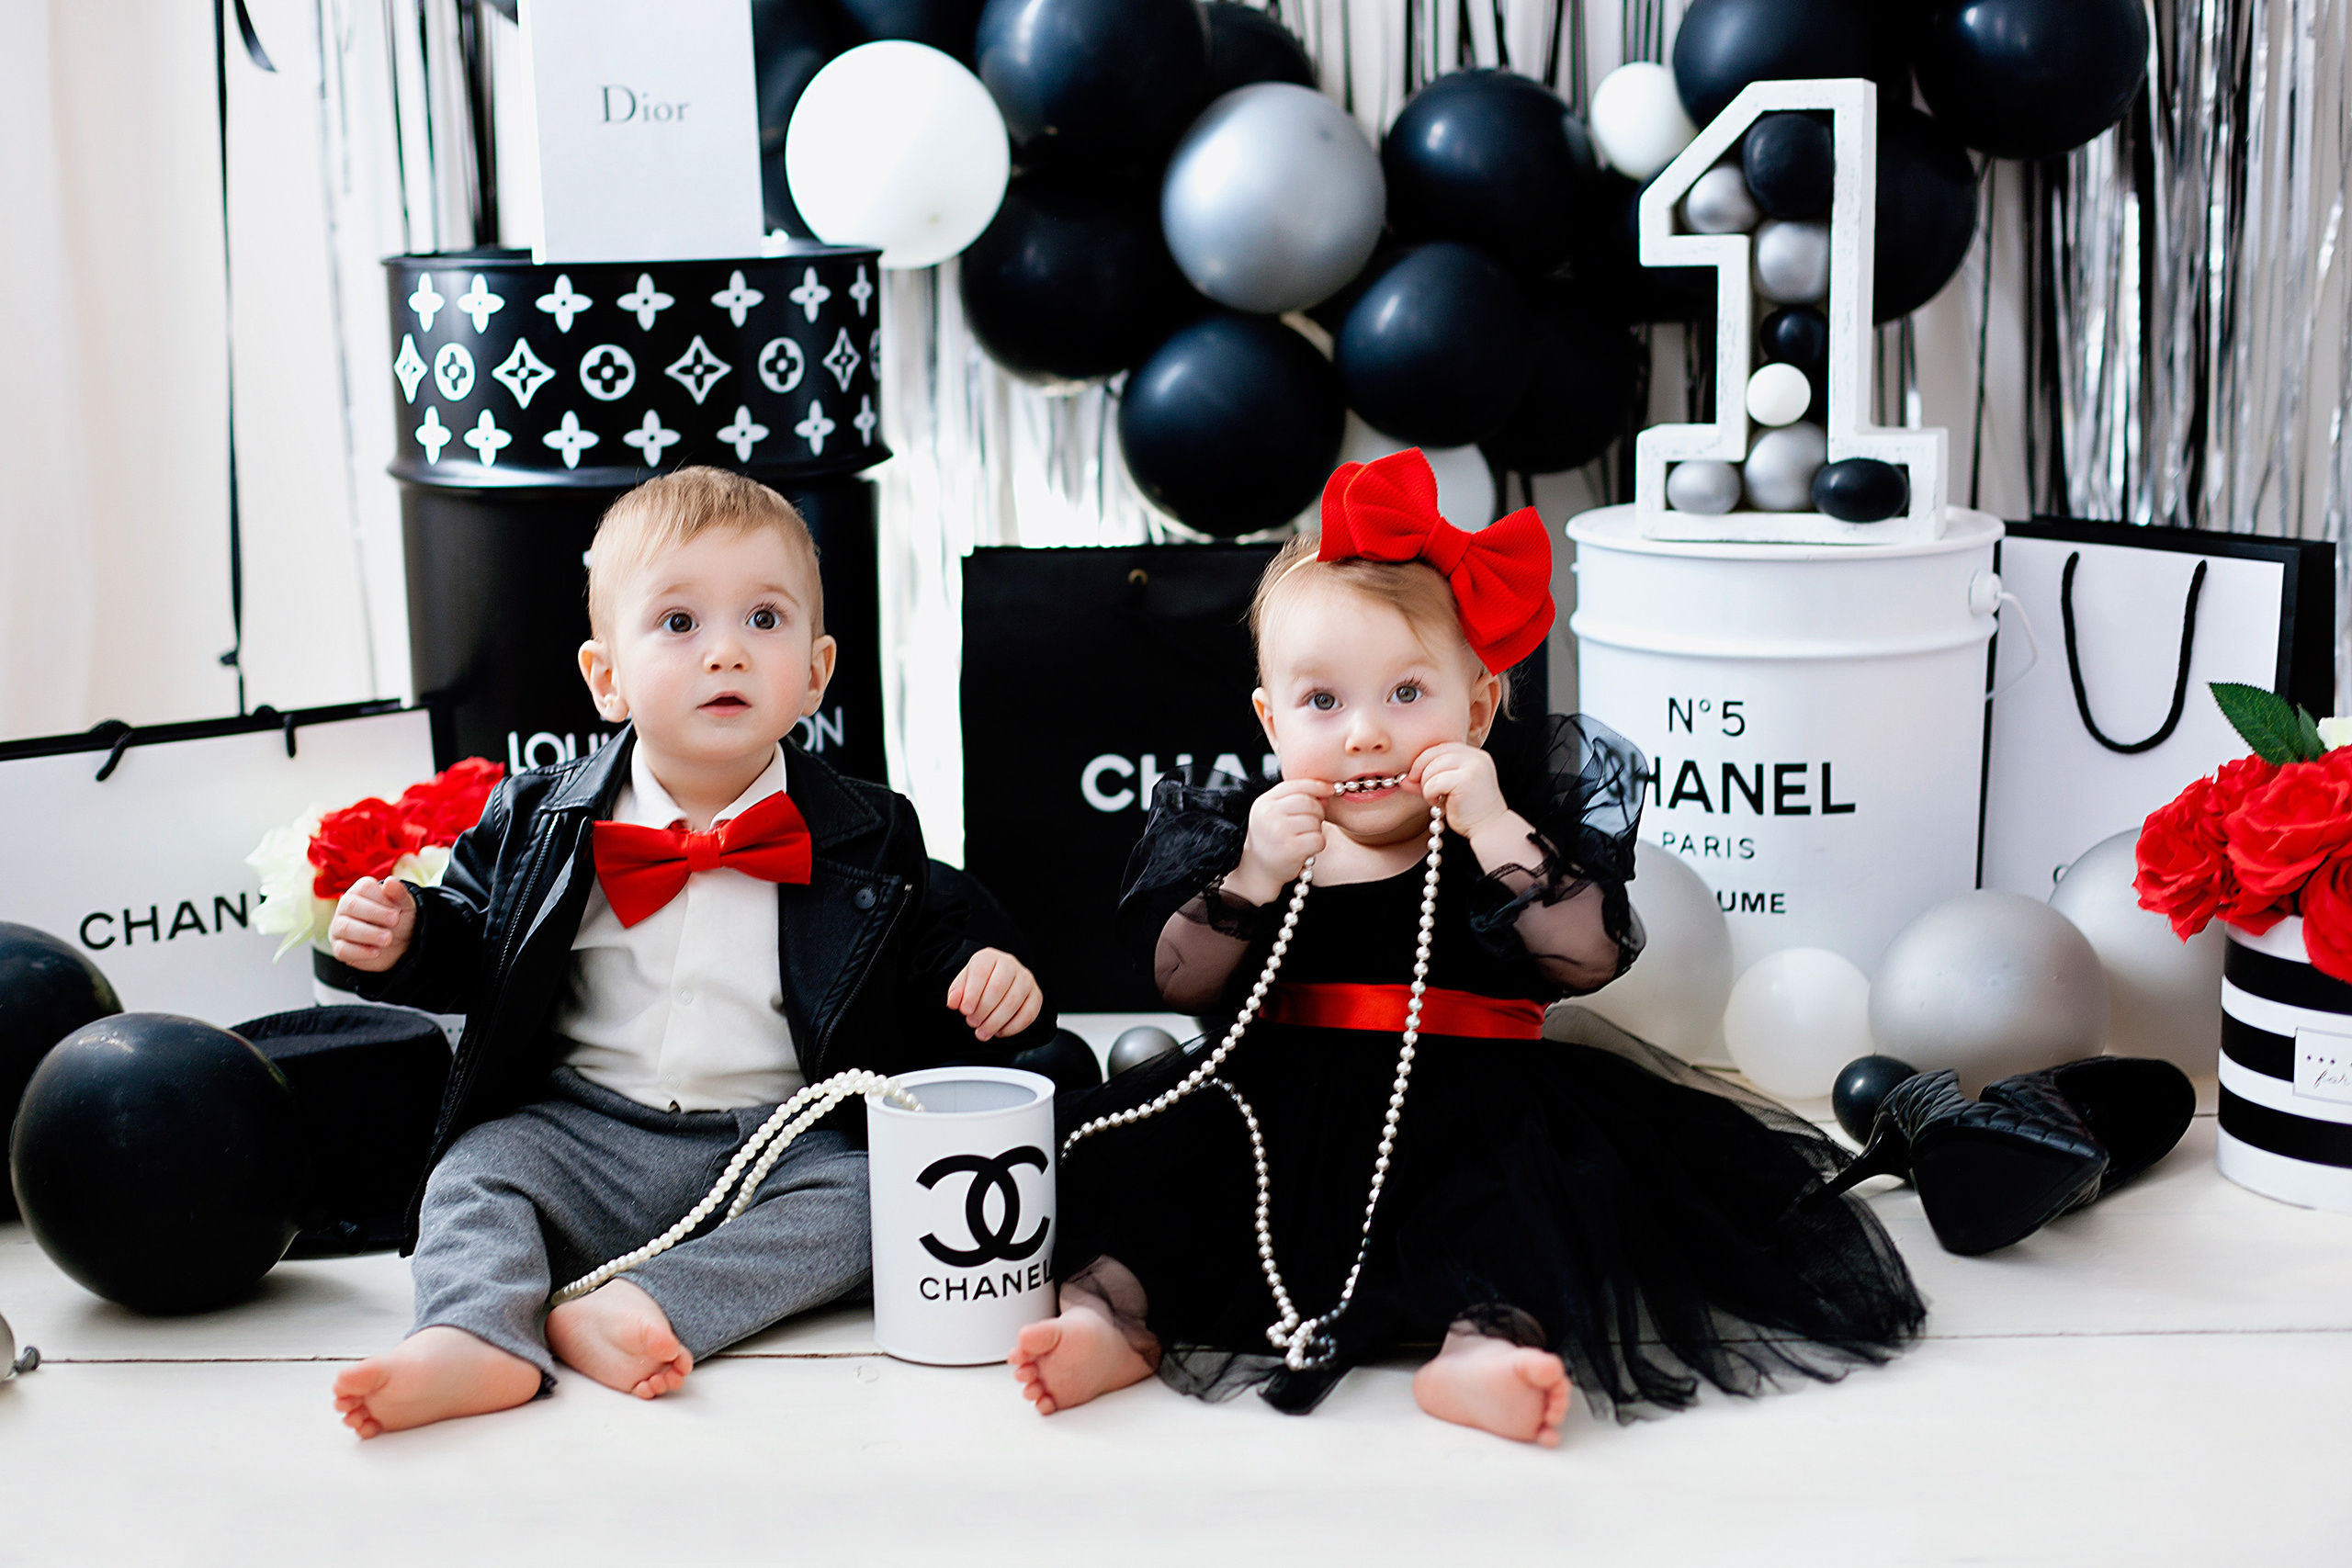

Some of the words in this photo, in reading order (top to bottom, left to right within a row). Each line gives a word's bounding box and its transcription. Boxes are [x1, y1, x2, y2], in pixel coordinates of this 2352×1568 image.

[599, 85, 690, 124] Dior
[507, 730, 610, 776] LOU
[1080, 753, 1281, 812] CHA
[1662, 830, 1755, 860] PARIS
[79, 892, 267, 951] CHAN
[919, 1259, 1054, 1301] CHANEL
